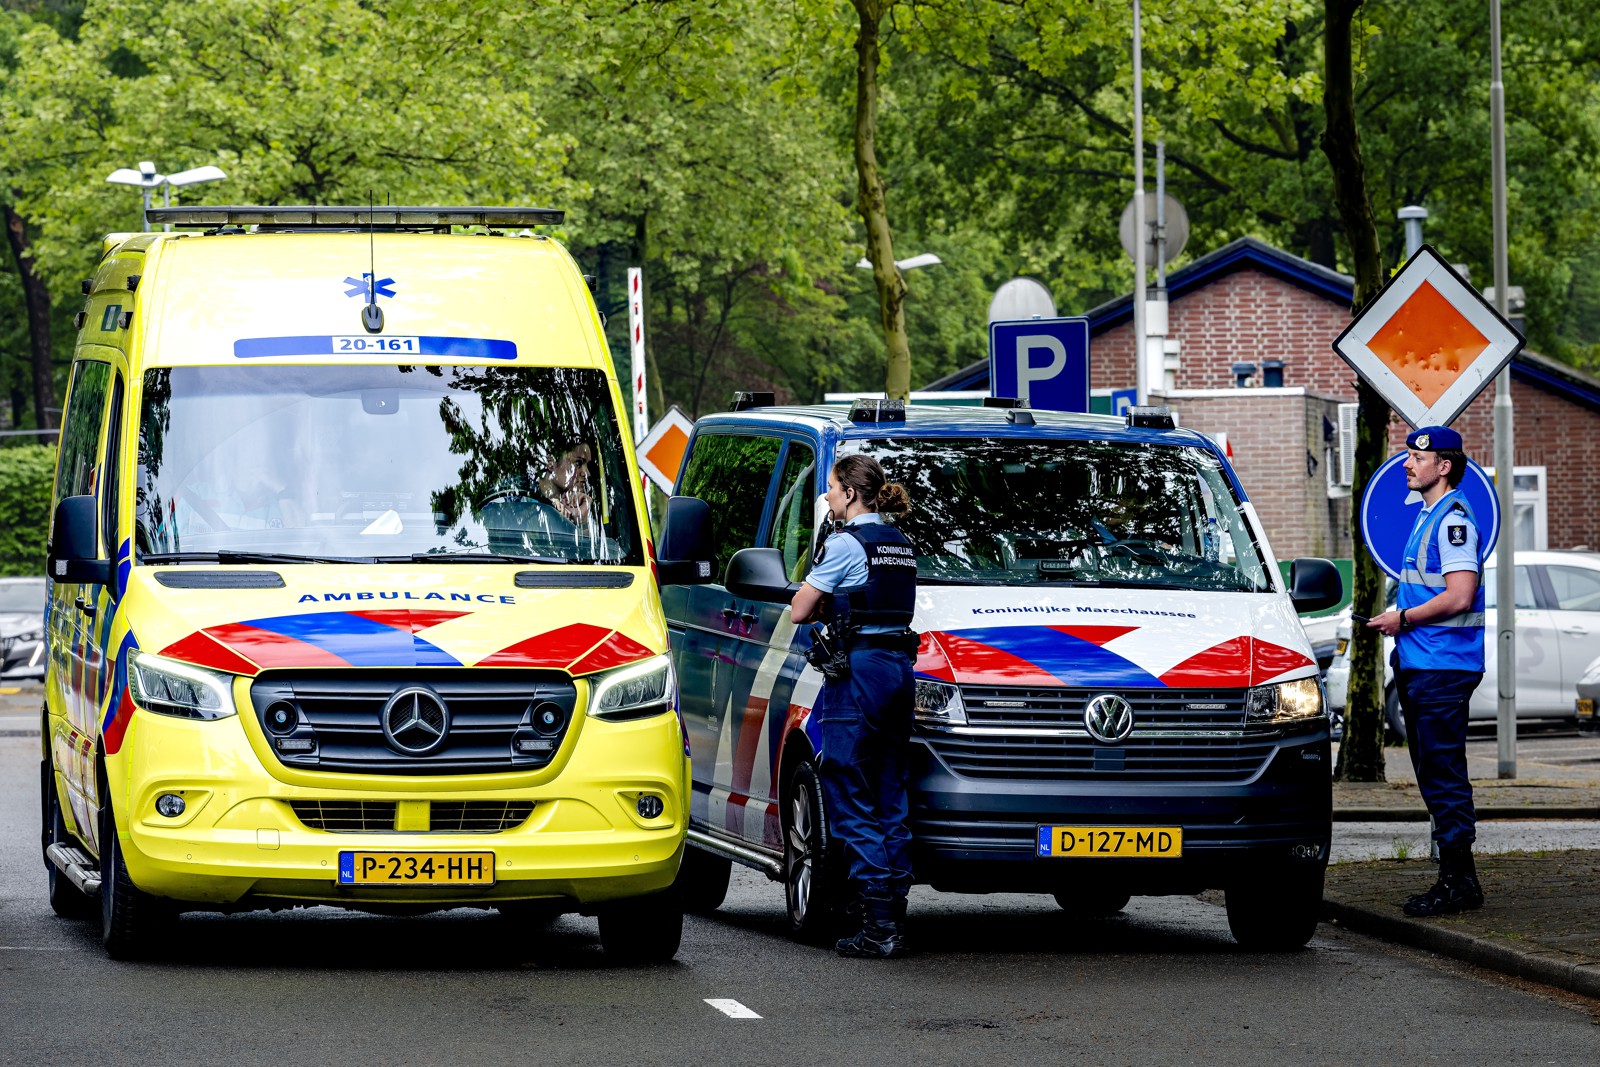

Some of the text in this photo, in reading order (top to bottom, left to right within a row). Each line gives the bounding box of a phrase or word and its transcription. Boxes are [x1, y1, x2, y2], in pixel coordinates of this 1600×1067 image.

[339, 339, 413, 351] 20-161
[1016, 334, 1067, 401] P
[298, 591, 516, 604] AMBULANCE
[971, 606, 1197, 618] Koninklijke Marechaussee
[1040, 831, 1172, 853] NL D-127-MD
[342, 857, 482, 880] NL P-234-HH
